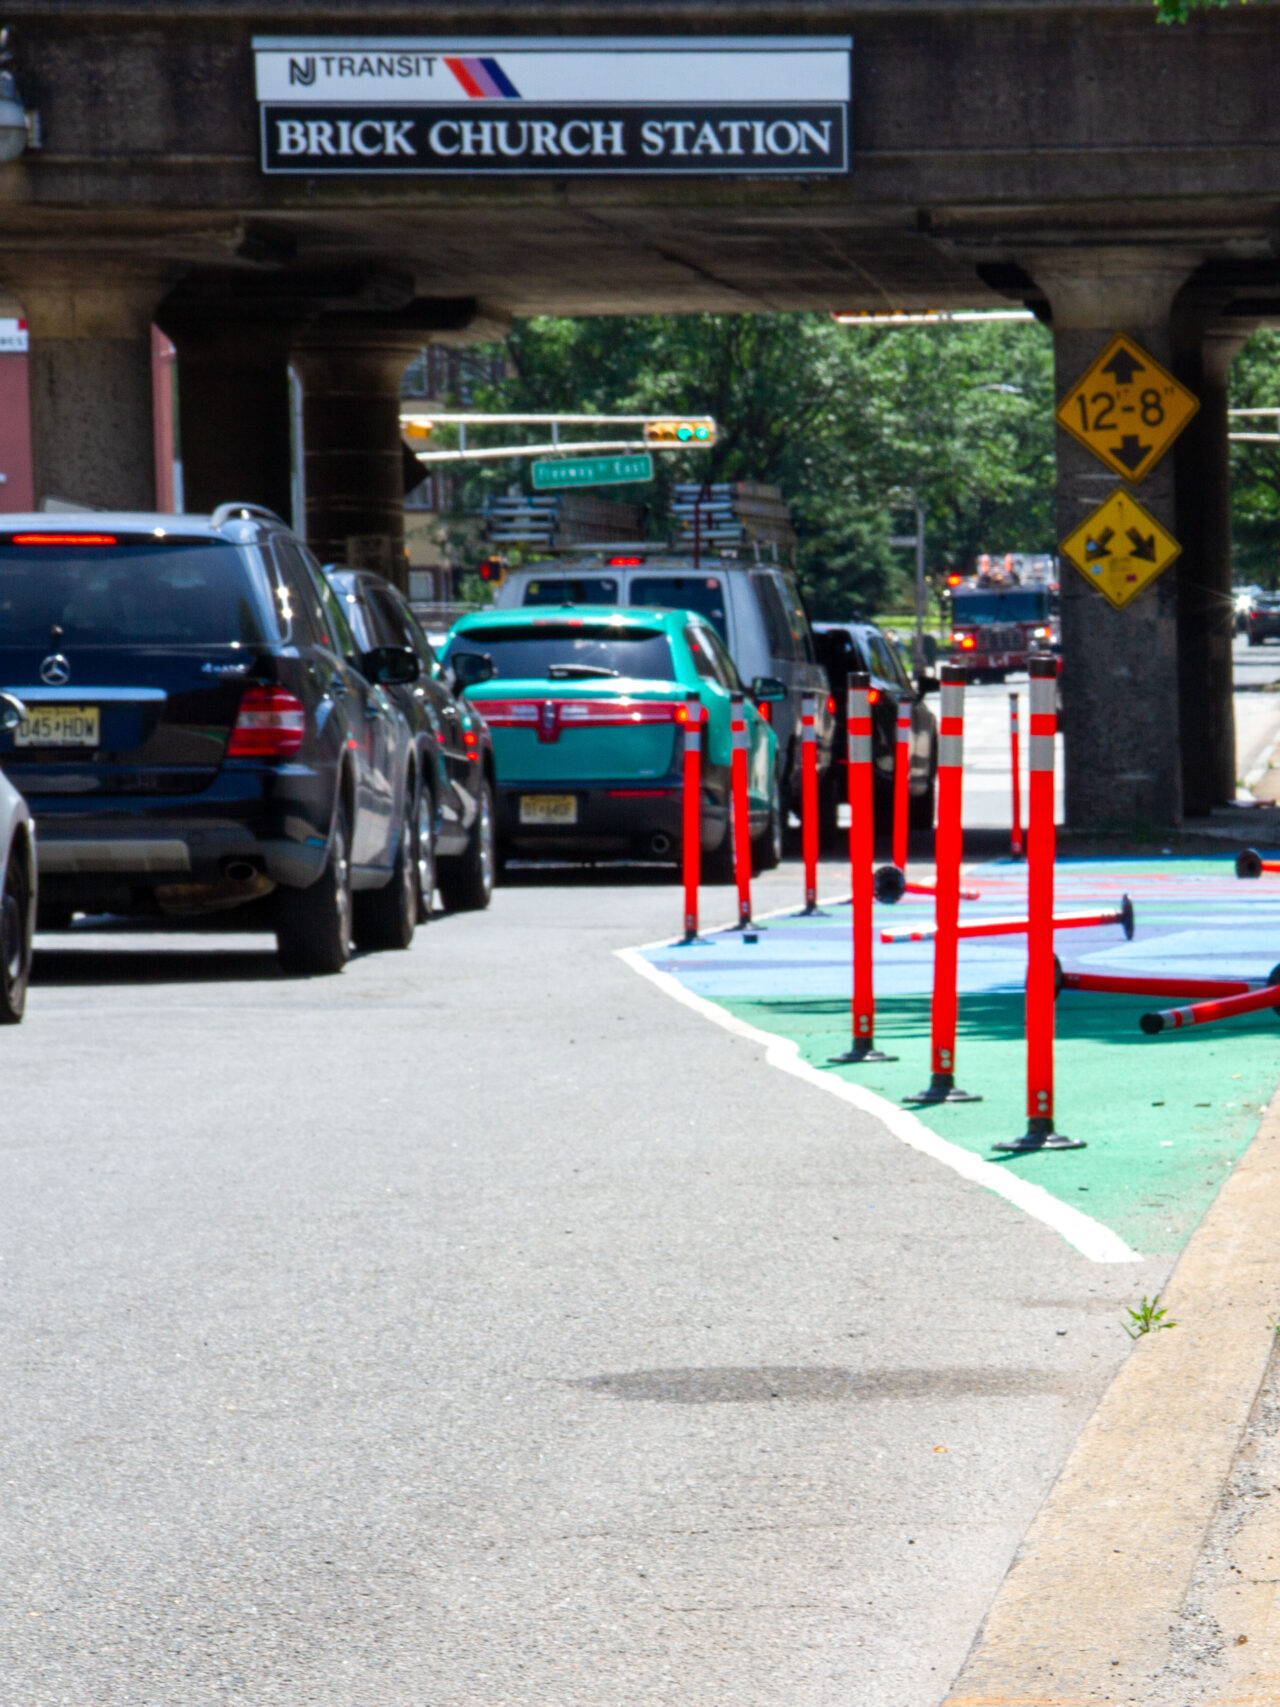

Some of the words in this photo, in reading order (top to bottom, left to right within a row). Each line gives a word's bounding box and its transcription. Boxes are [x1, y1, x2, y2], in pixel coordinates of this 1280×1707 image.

[289, 57, 317, 86] NJ
[320, 56, 438, 78] TRANSIT
[276, 119, 418, 156] BRICK
[429, 119, 627, 156] CHURCH
[641, 119, 832, 156] STATION
